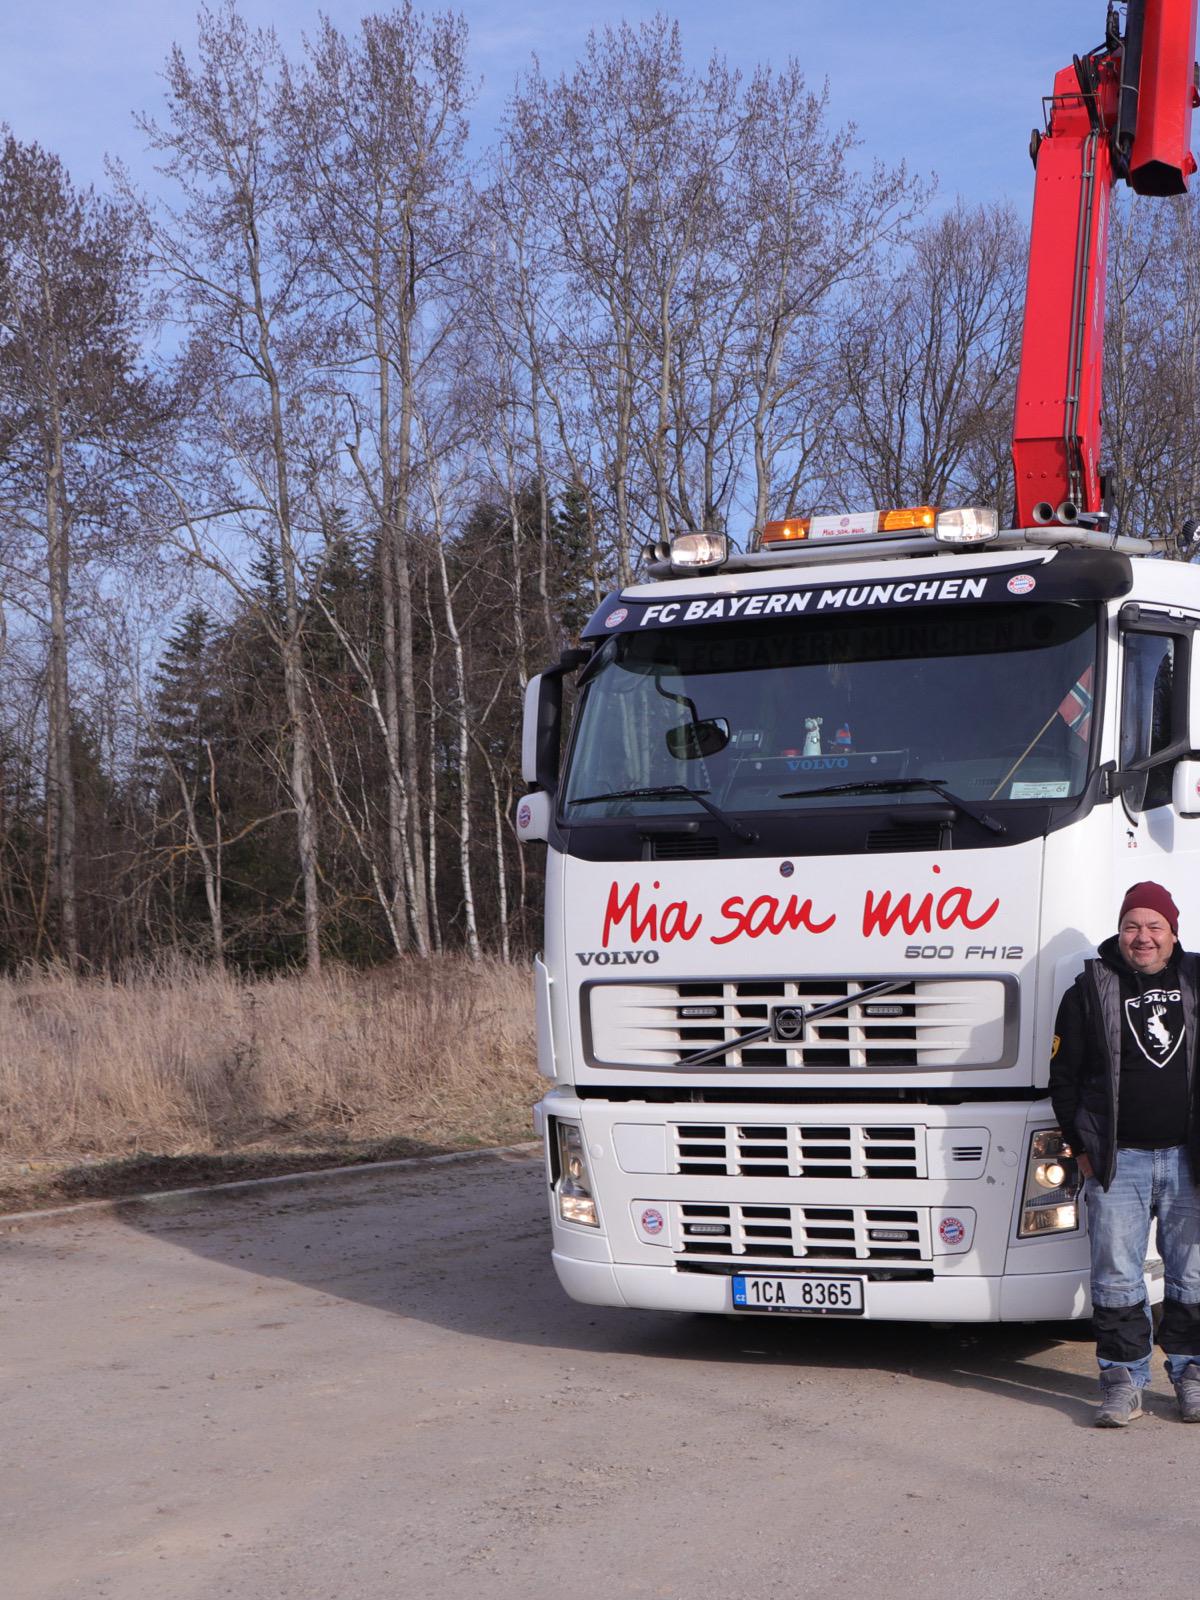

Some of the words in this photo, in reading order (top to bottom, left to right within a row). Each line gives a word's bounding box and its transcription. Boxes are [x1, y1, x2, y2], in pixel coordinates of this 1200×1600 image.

[640, 604, 681, 627] FC
[683, 592, 813, 621] BAYERN
[816, 578, 988, 610] MUNCHEN
[786, 758, 848, 771] VOLVO
[602, 880, 702, 948] Mia
[710, 894, 836, 945] san
[862, 864, 1000, 938] mia
[575, 949, 660, 966] VOLVO
[904, 945, 954, 960] 500
[735, 1294, 746, 1302] CZ
[751, 1280, 786, 1304] 1CA
[801, 1282, 852, 1306] 8365
